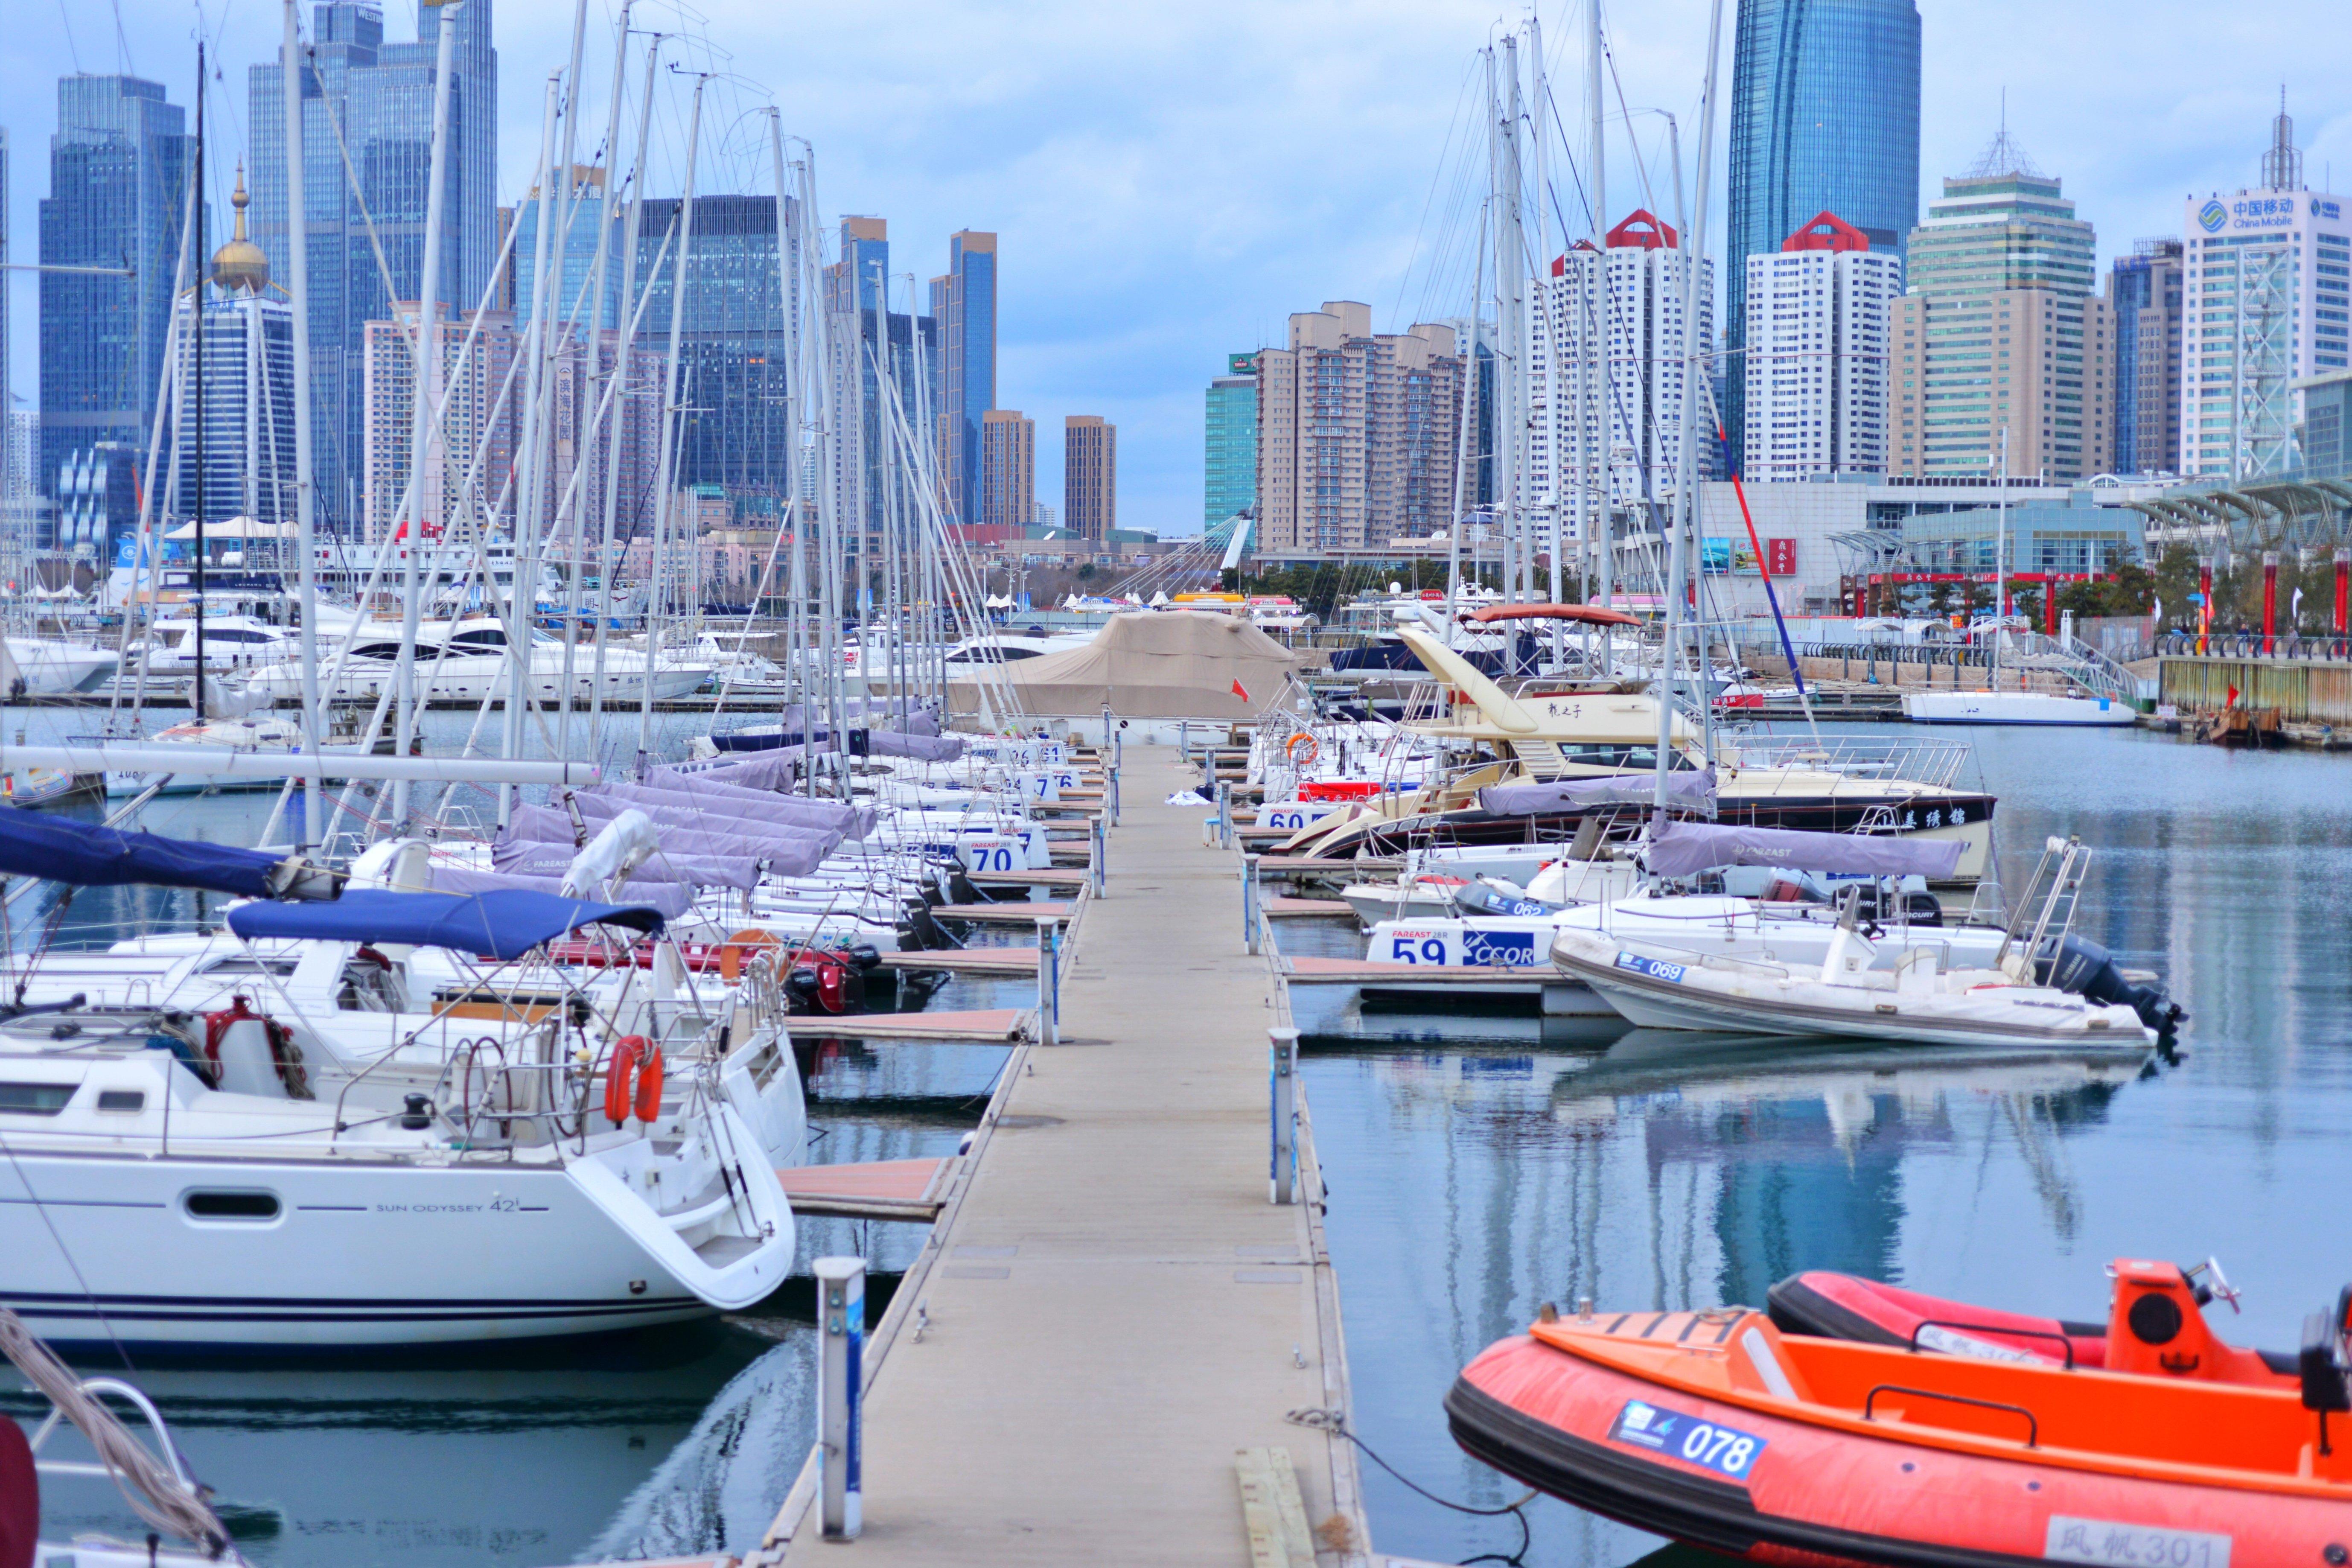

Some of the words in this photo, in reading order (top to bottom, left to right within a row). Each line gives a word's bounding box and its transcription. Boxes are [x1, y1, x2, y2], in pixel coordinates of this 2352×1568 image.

[2233, 197, 2294, 217] 中国移动
[2234, 219, 2260, 228] China
[2262, 216, 2293, 227] Mobile
[1269, 813, 1303, 828] 60
[972, 848, 1011, 871] 70
[1746, 847, 1792, 857] FAREAST
[1513, 902, 1542, 917] 062
[1838, 898, 1877, 907] MEURY
[1393, 938, 1446, 966] 59
[1649, 961, 1682, 980] 069
[2065, 953, 2083, 975] YAMAHA
[1682, 1423, 1754, 1472] 078
